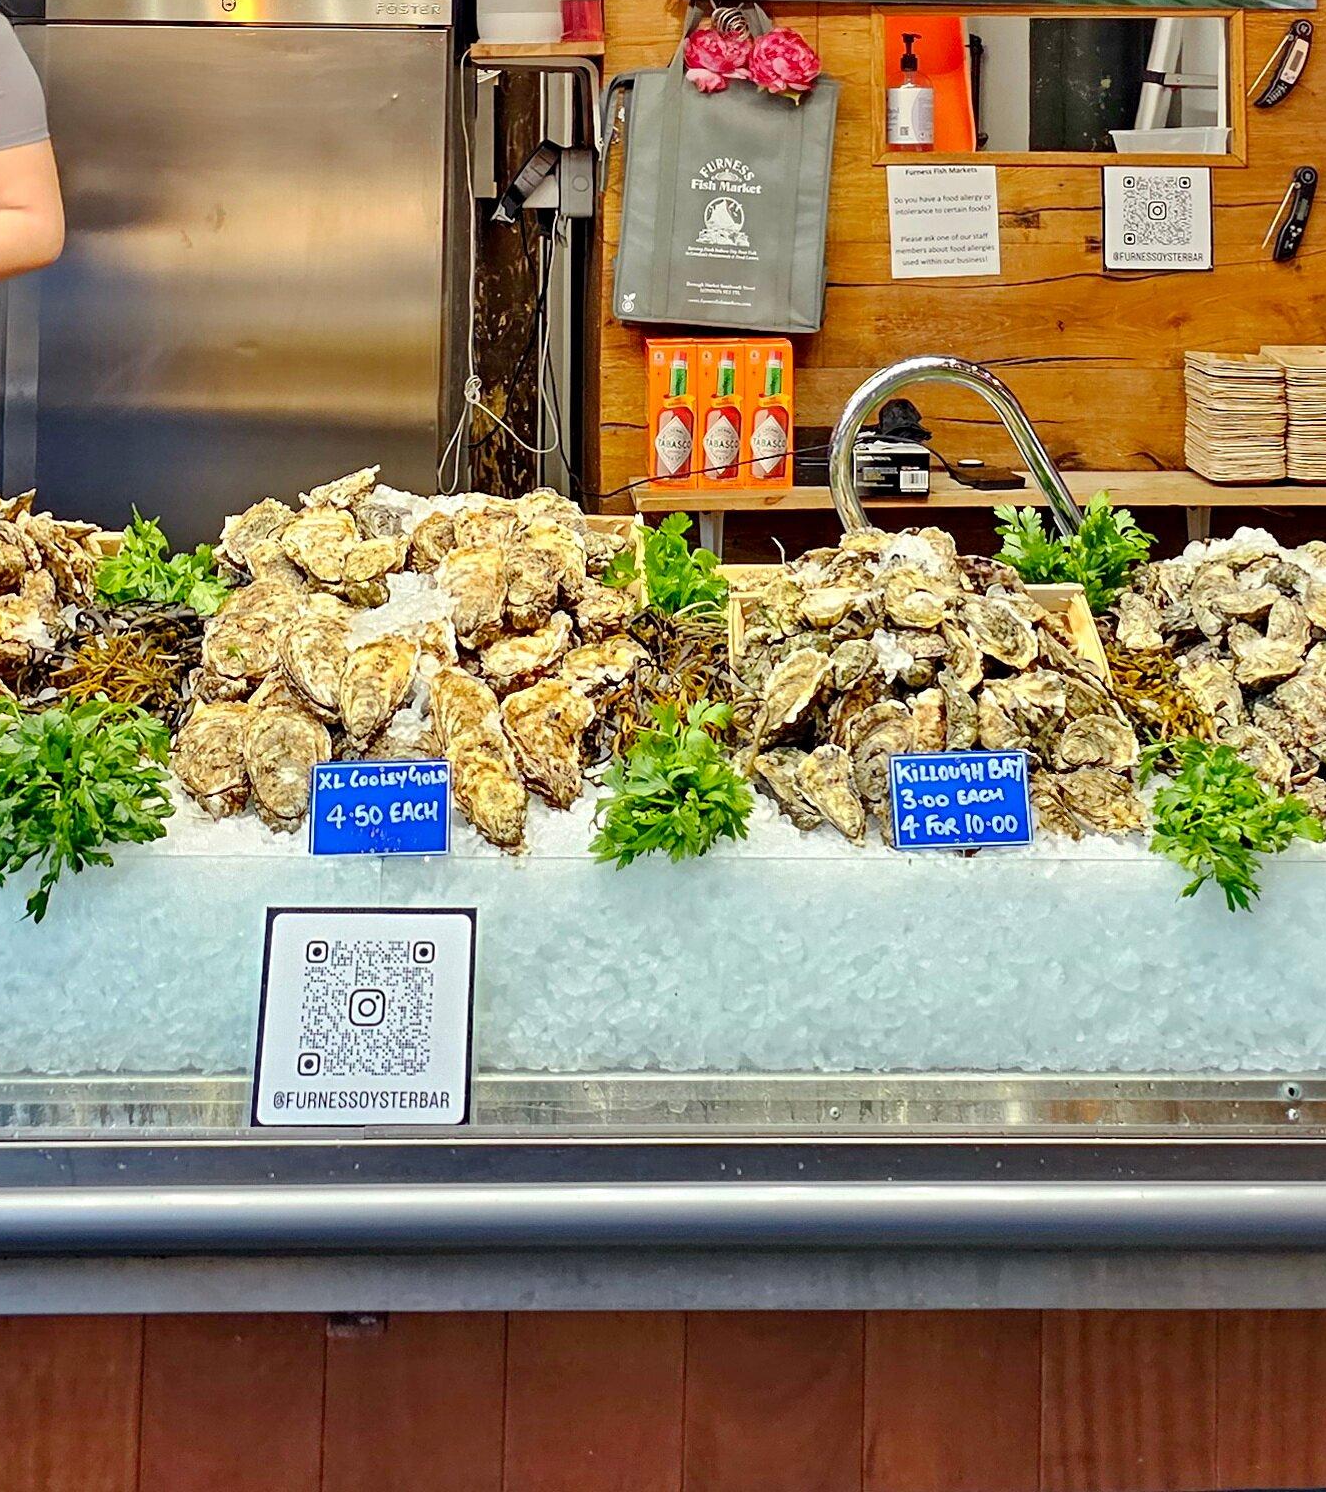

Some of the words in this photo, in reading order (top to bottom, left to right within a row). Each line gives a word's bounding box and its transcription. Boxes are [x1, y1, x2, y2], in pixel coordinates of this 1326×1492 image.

[375, 2, 441, 15] FOSTER
[698, 157, 755, 182] FURNESS
[905, 168, 932, 176] Furness
[933, 167, 947, 175] Fish
[690, 178, 717, 191] Fish
[719, 181, 762, 195] Market
[905, 197, 918, 205] you
[960, 193, 983, 202] allergy
[895, 207, 934, 215] intolerance
[943, 206, 968, 214] certain
[968, 204, 992, 212] foods?
[900, 235, 924, 243] Please
[924, 234, 935, 242] ask
[972, 232, 989, 240] staff
[895, 246, 927, 254] members
[902, 258, 920, 266] used
[956, 256, 989, 264] business!
[1113, 251, 1204, 262] @FURNESSOYSTERBAR
[658, 438, 691, 449] TABASCO
[706, 438, 739, 449] TABASCO
[753, 437, 786, 448] TABASCO
[987, 757, 1022, 782] BAY
[318, 771, 346, 791] XL
[408, 765, 448, 787] GOLD
[956, 788, 1005, 806] EACH
[389, 800, 439, 824] EACH
[900, 814, 920, 839] 4
[925, 814, 961, 836] FOR
[272, 1090, 451, 1110] @FURNESSOYSTERBAR
